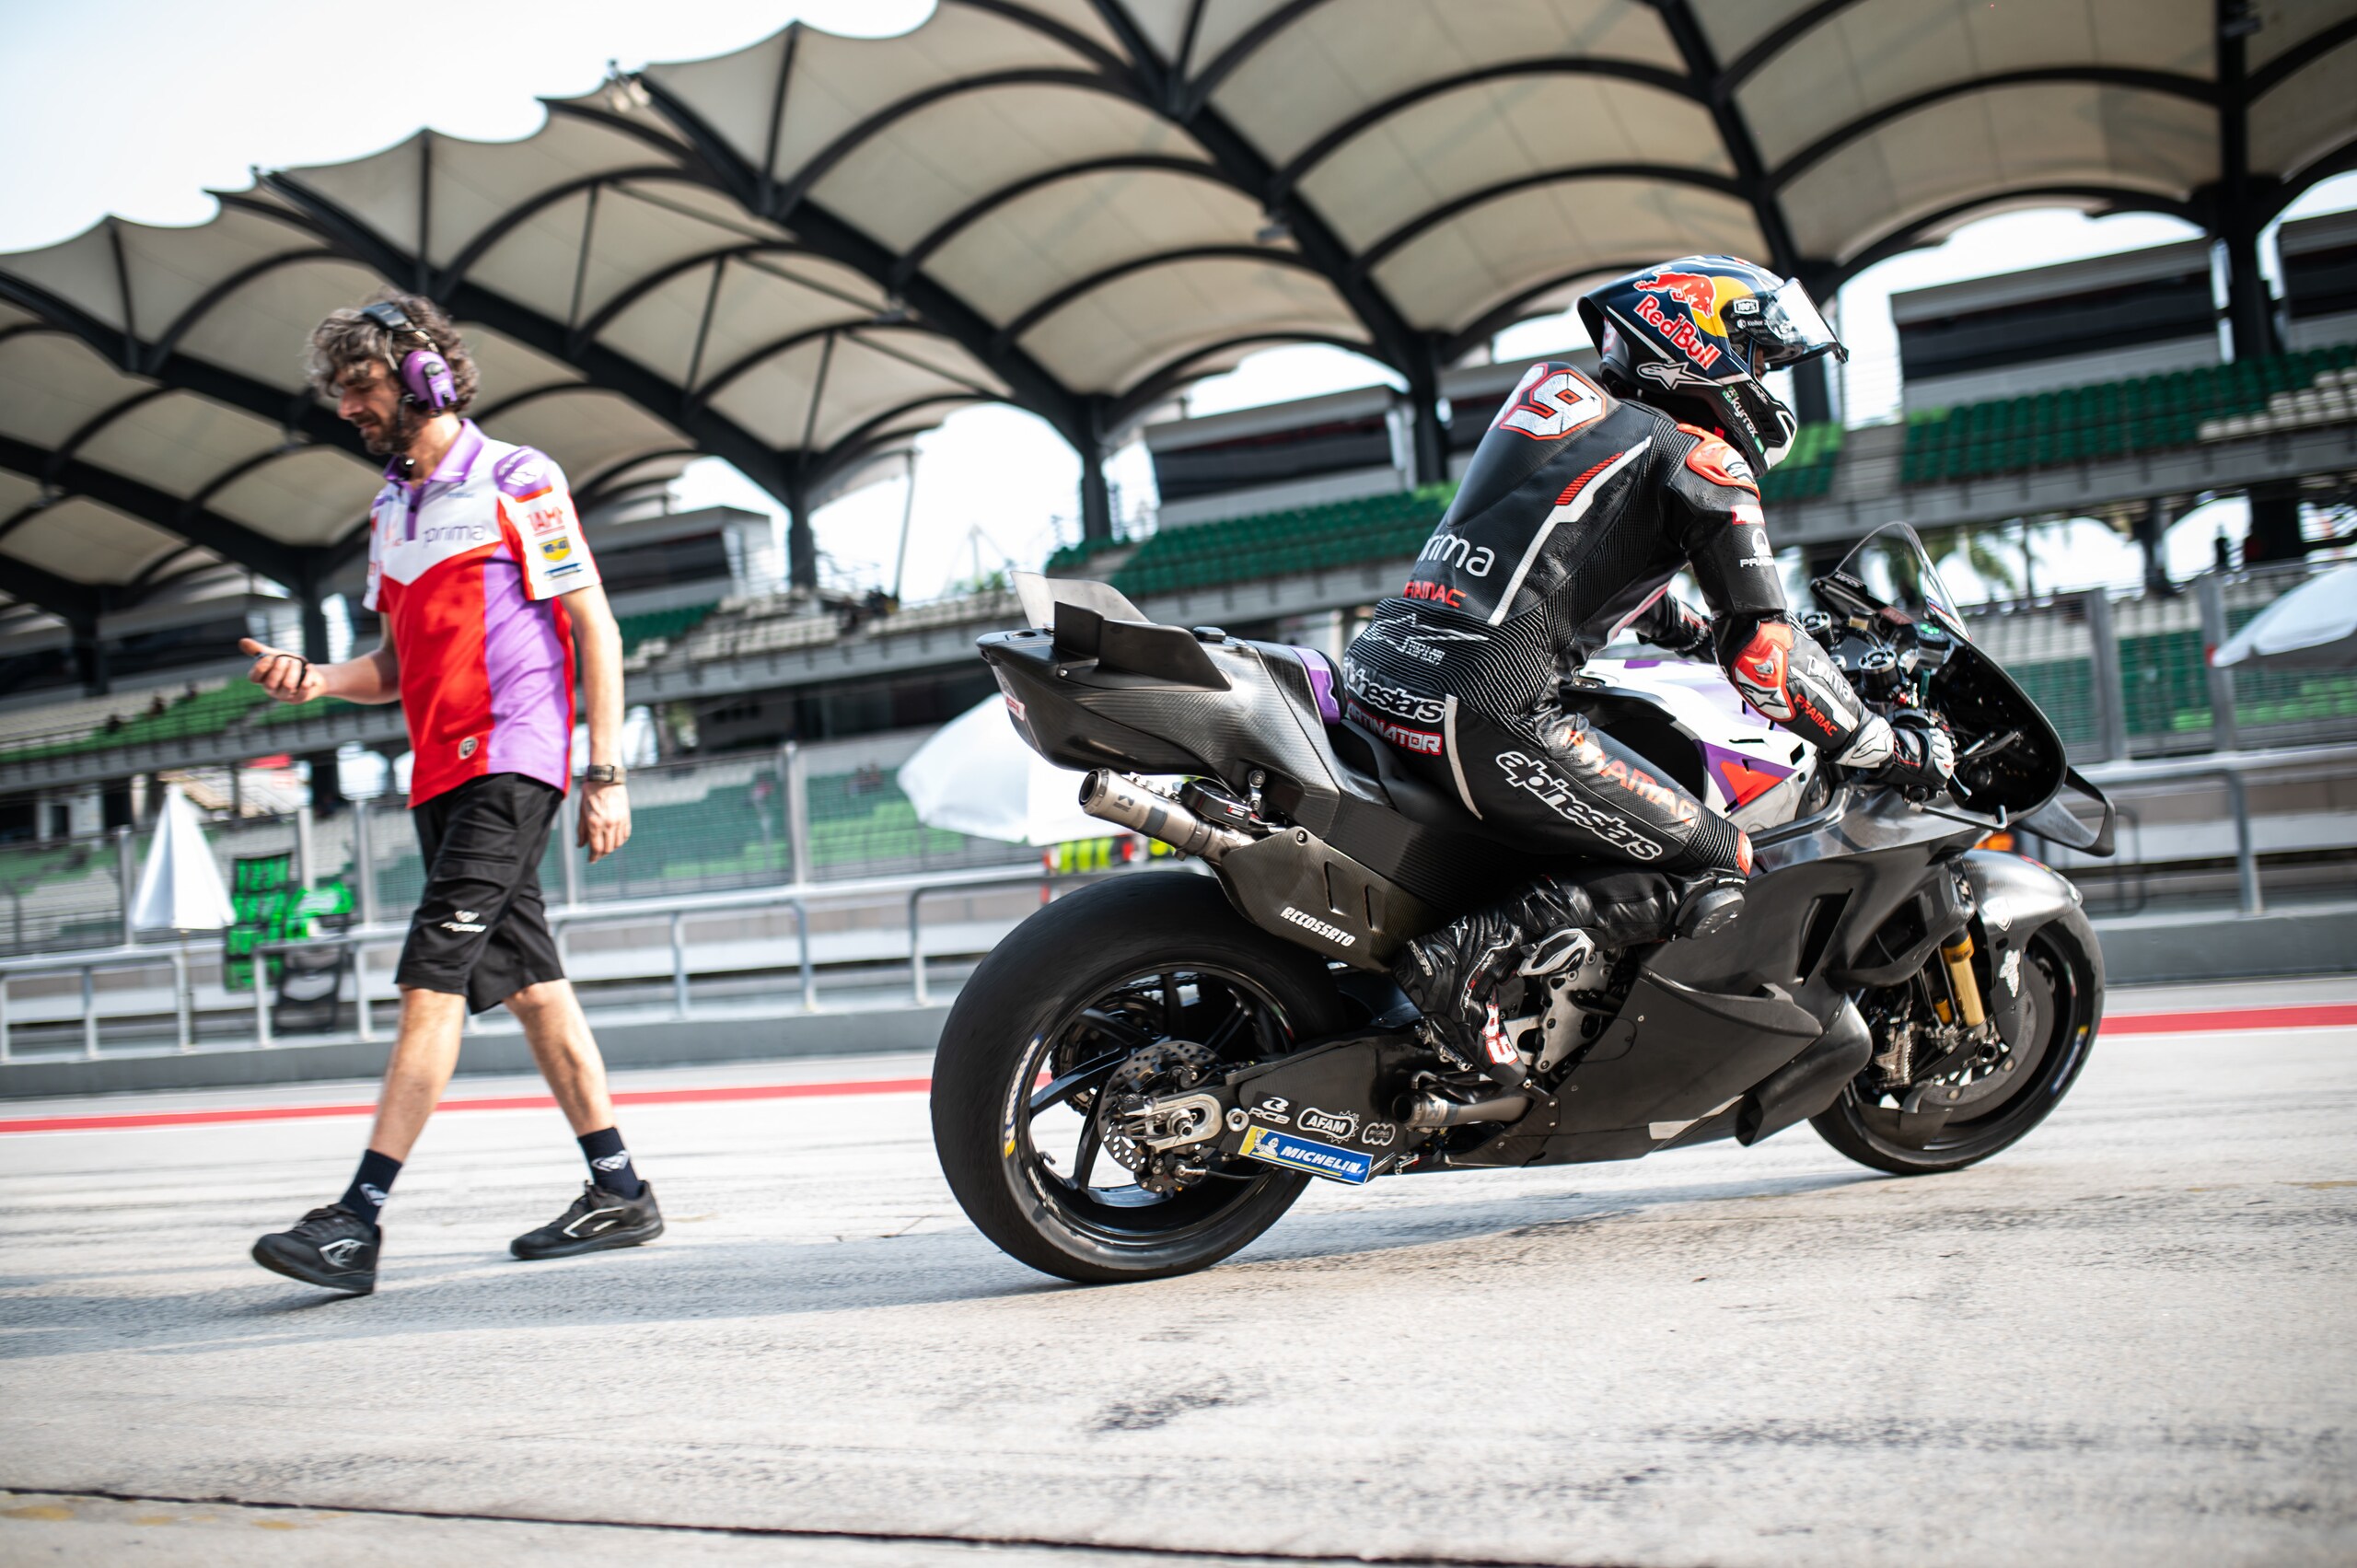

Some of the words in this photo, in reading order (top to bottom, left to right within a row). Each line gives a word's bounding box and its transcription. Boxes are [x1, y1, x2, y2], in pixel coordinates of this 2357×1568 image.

[1730, 396, 1759, 438] kyrrex
[423, 525, 486, 549] prima
[1417, 533, 1495, 577] rima
[1280, 906, 1356, 947] ACCOSSATO
[1248, 1107, 1291, 1125] RCB
[1306, 1115, 1347, 1133] AFAM
[1280, 1145, 1362, 1174] MICHELIN
